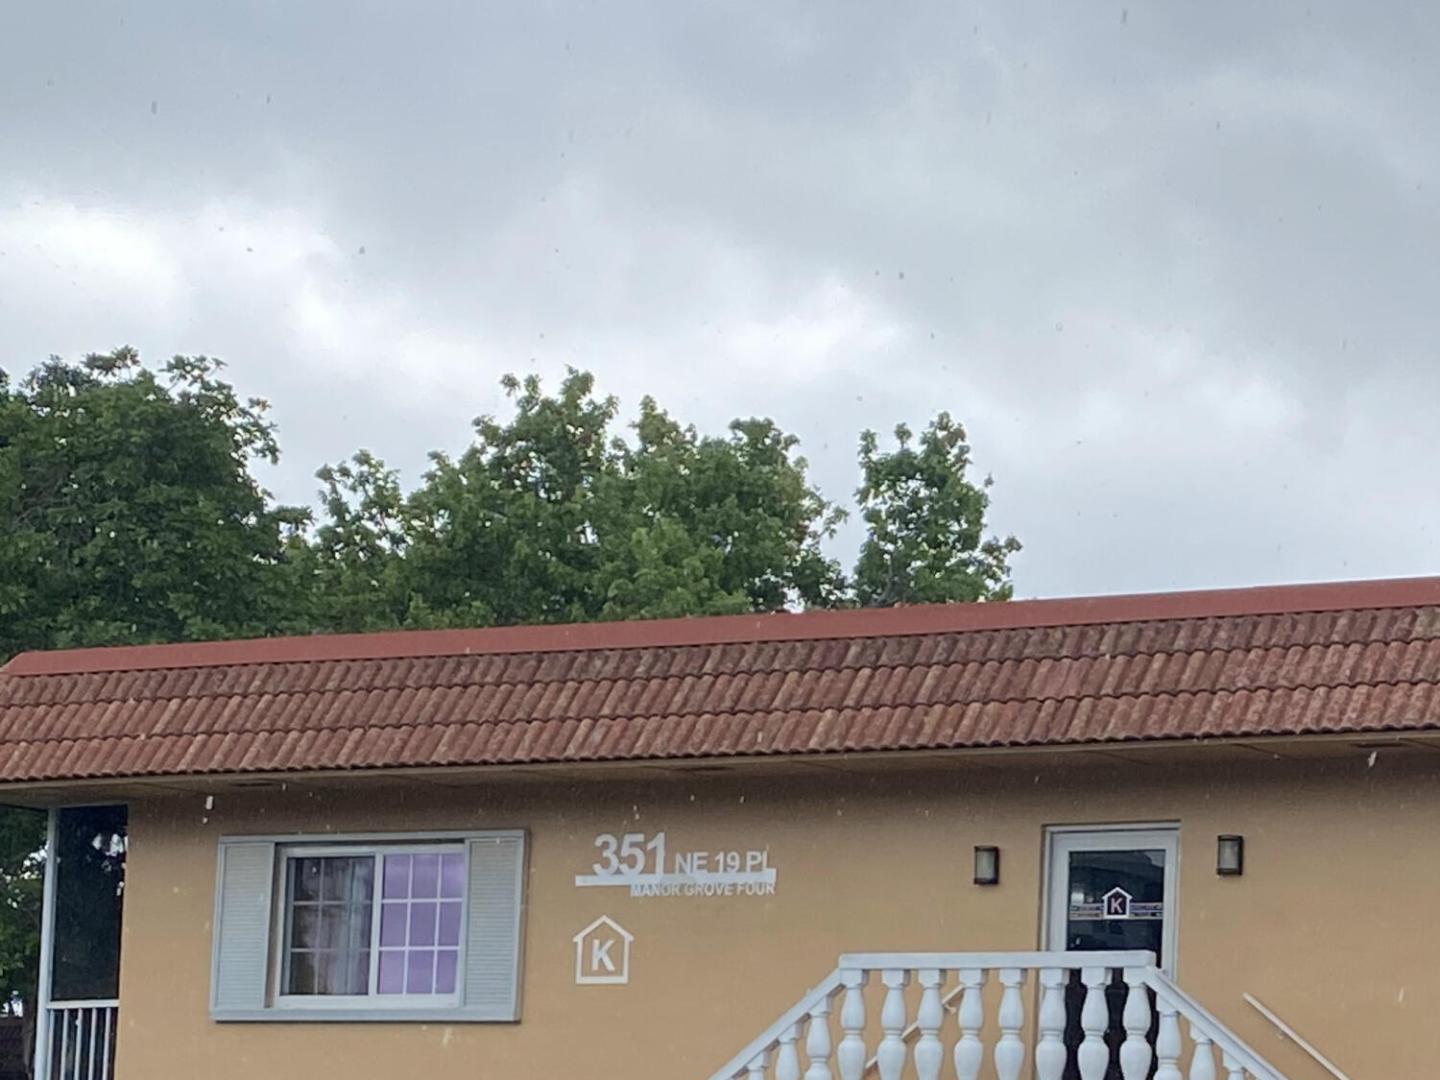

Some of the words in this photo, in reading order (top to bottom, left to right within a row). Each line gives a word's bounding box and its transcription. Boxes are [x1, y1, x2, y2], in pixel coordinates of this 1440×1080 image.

[592, 832, 666, 876] 351
[675, 852, 708, 874] NE
[714, 852, 740, 874] 19
[630, 884, 680, 897] MANOR
[683, 883, 734, 897] GROVE
[736, 882, 776, 896] FOUR
[1110, 897, 1123, 914] K
[591, 938, 616, 972] K
